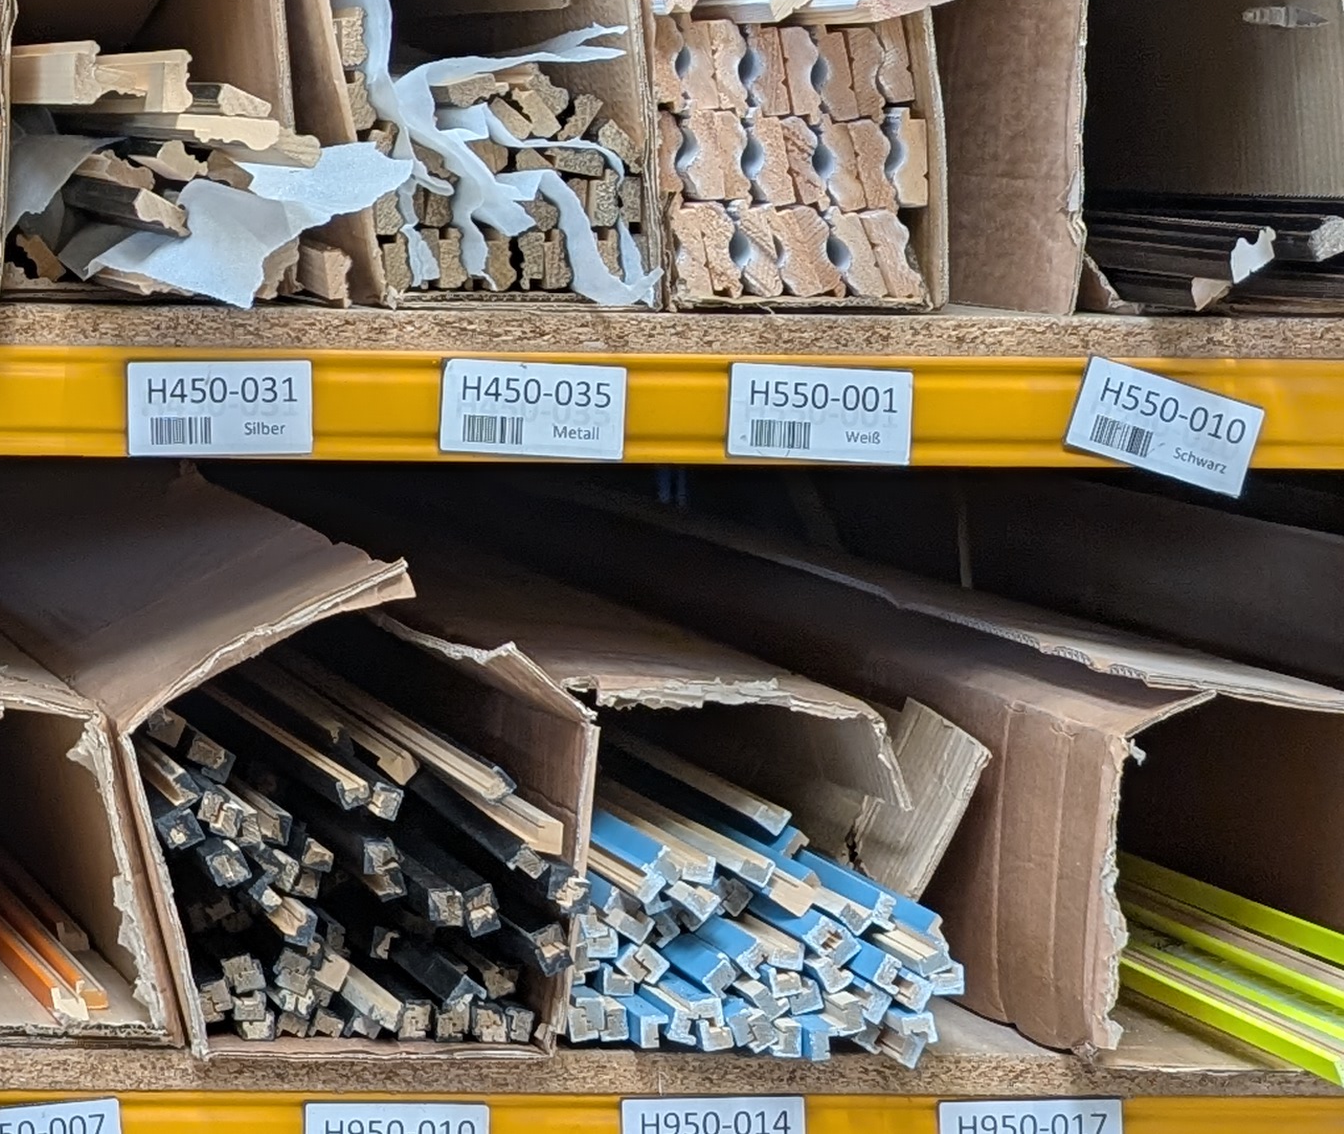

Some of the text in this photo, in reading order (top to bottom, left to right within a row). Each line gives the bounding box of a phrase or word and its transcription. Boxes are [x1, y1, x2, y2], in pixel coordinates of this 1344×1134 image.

[147, 376, 298, 405] H450-031
[462, 375, 611, 409] H450-035
[750, 379, 898, 414] H550-001
[1099, 376, 1246, 445] H550-010
[244, 421, 286, 436] Silber
[552, 423, 600, 441] Metall
[845, 430, 881, 445] Weiß
[1172, 446, 1228, 474] Schwarz
[640, 1109, 792, 1134] H950-014
[958, 1112, 1108, 1134] H950-017
